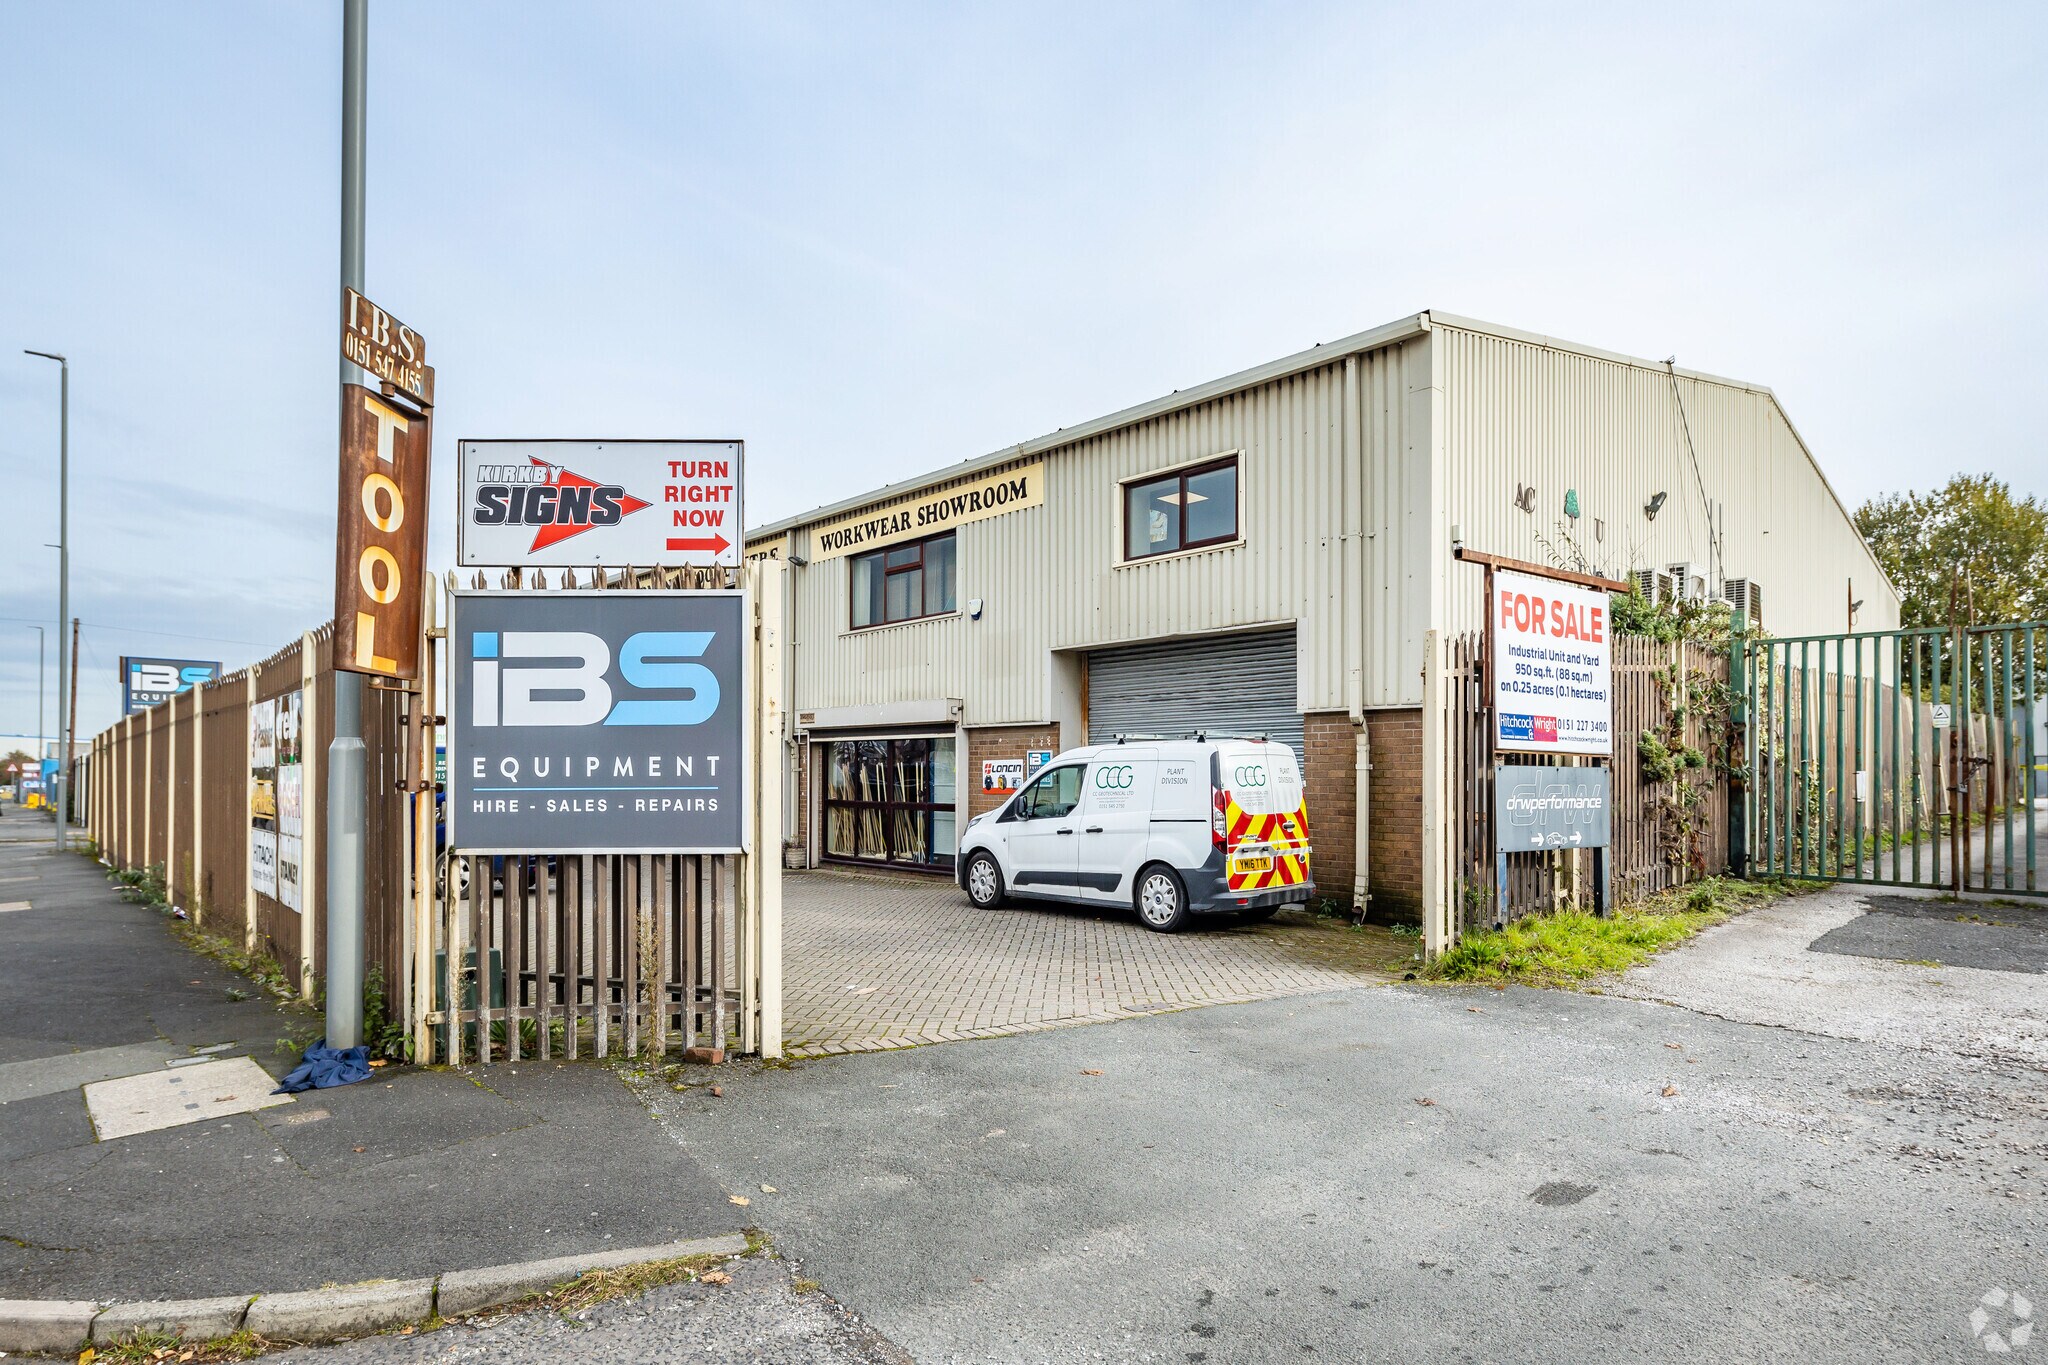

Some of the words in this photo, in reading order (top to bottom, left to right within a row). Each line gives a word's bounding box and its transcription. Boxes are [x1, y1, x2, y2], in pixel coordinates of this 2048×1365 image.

[346, 288, 421, 368] I.B.S.
[346, 332, 370, 368] 0151
[375, 350, 394, 380] 547
[398, 365, 421, 397] 4155
[476, 465, 564, 483] KIRKBY
[668, 461, 728, 478] TURN
[665, 486, 733, 502] RIGHT
[473, 485, 625, 526] SIGNS
[820, 511, 912, 552] WORKWEAR
[917, 476, 1028, 527] SHOWROOM
[673, 510, 724, 527] NOW
[356, 395, 409, 674] TOOL
[1501, 590, 1546, 635] FOR
[1551, 600, 1602, 643] SALE
[1509, 644, 1548, 660] Industrial
[1549, 649, 1565, 662] Unit
[1567, 653, 1580, 664] and
[1582, 654, 1599, 667] Yard
[1515, 663, 1532, 676] 950
[1534, 666, 1554, 679] sq.ft.
[1556, 667, 1570, 681] (88
[1571, 671, 1593, 685] sq.m)
[1501, 681, 1511, 691] on
[1513, 681, 1531, 693] 0.25
[1533, 685, 1554, 696] acres
[1571, 686, 1606, 702] hectares)
[1500, 714, 1533, 729] Hitchcock
[1534, 716, 1556, 732] Wright
[1557, 719, 1573, 730] 0151
[1576, 720, 1588, 731] 227
[1590, 721, 1607, 732] 3400
[1528, 729, 1534, 740] &
[473, 755, 720, 783] EQUIPMENT
[1096, 765, 1133, 788] CCG
[1235, 766, 1266, 787] CCG
[1161, 777, 1188, 785] DIVISION
[473, 800, 519, 812] HIRE
[546, 799, 608, 812] SALES
[635, 799, 718, 812] REPAIRS
[1506, 795, 1602, 814] drwperformance
[1256, 858, 1268, 868] TTK
